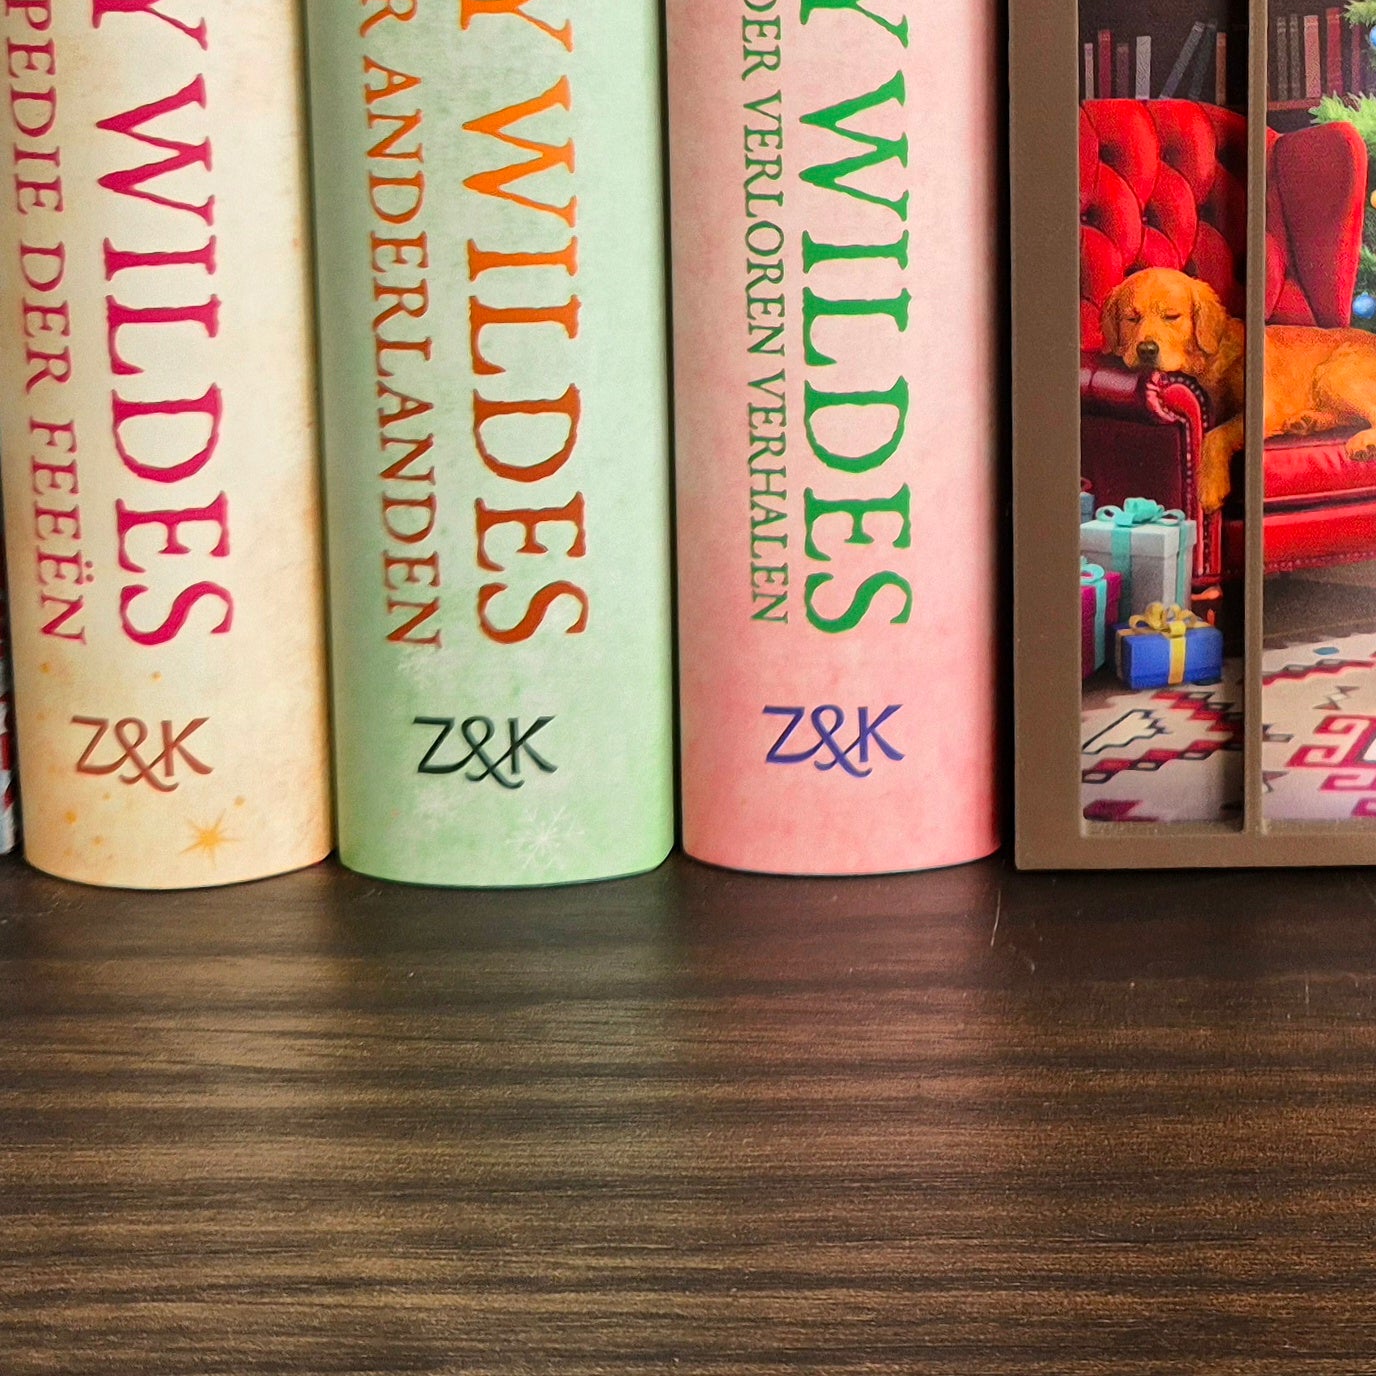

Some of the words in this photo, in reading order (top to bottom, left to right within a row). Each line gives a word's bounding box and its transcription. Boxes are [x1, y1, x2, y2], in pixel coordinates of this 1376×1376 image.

[18, 239, 74, 394] DER
[362, 54, 442, 648] ANDERLANDEN
[741, 90, 786, 358] VERLOREN
[797, 69, 913, 635] WILDES
[95, 73, 233, 646] WILDES
[461, 74, 589, 645] WILDES
[29, 416, 95, 645] FEEËN
[745, 368, 789, 625] VERHALEN
[70, 714, 214, 792] Z&K
[412, 714, 558, 790] Z&K
[761, 703, 906, 779] Z&K
